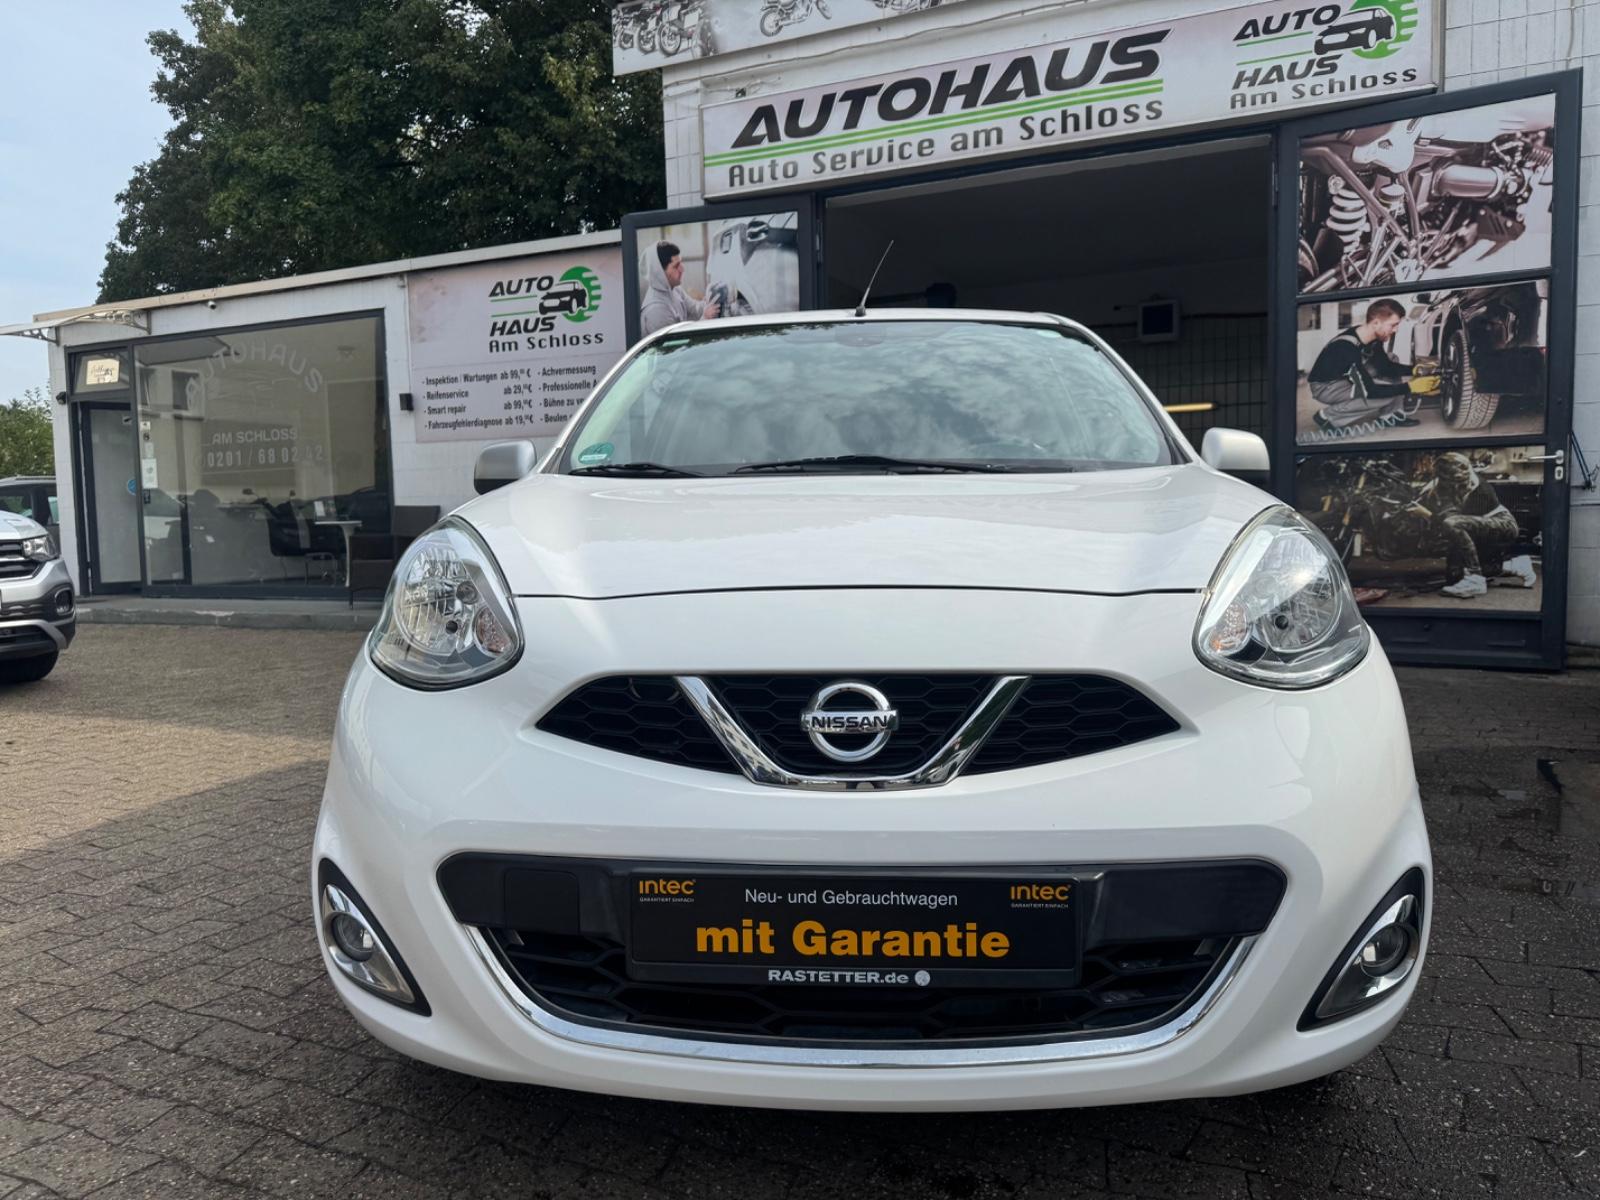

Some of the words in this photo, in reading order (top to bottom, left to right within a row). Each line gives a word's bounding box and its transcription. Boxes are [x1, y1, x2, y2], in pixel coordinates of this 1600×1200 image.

[1233, 4, 1341, 41] AUTO
[1232, 53, 1344, 90] HAUS
[731, 28, 1172, 148] AUTOHAUS
[1230, 90, 1277, 109] Am
[1292, 68, 1417, 99] Schloss
[728, 159, 799, 188] Auto
[812, 134, 935, 175] Service
[950, 123, 1003, 152] am
[1019, 100, 1164, 140] Schloss
[488, 275, 554, 297] AUTO
[489, 316, 557, 337] HAUS
[489, 339, 519, 353] Am
[527, 333, 604, 350] Schloss
[186, 340, 323, 411] AUTOHAUS
[542, 380, 591, 392] Professionelle
[427, 405, 446, 415] Smart
[447, 404, 466, 415] repair
[211, 431, 233, 446] AM
[236, 427, 298, 444] SCHLOSS
[207, 449, 242, 468] 0201
[811, 714, 888, 729] NISSAN
[639, 878, 694, 895] intec
[1010, 884, 1070, 901] intec
[745, 888, 783, 904] Neu-
[787, 888, 817, 905] und
[822, 888, 958, 909] Gebrauchtwagen
[696, 919, 775, 954] mit
[792, 920, 1010, 957] Garantie
[768, 969, 909, 985] RASTETTER.de
